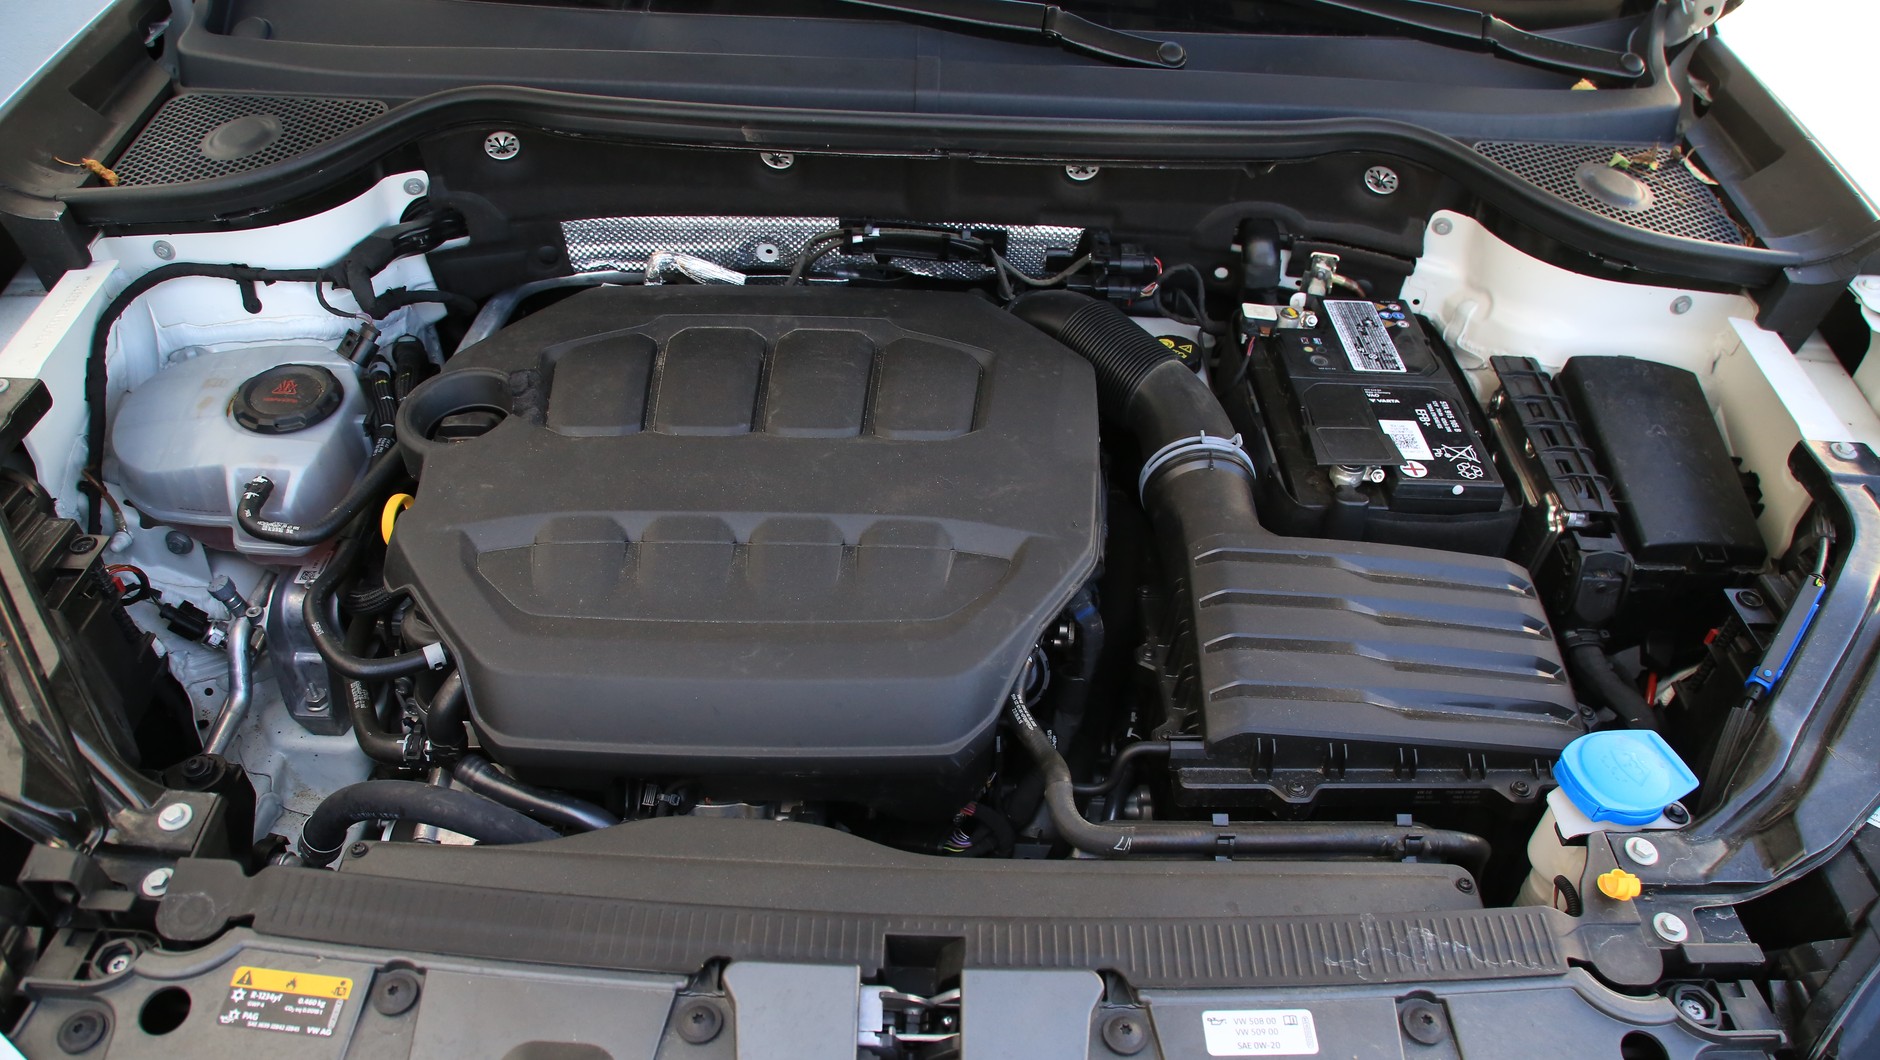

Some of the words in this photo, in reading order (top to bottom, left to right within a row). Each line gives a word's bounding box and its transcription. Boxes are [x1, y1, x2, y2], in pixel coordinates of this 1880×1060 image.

[1415, 409, 1431, 426] EFB+
[1432, 448, 1443, 457] Pb
[250, 991, 283, 1003] R-1234yf
[298, 997, 317, 1006] 0.460
[317, 999, 326, 1008] kg
[242, 1011, 259, 1021] PAG
[1266, 1017, 1276, 1025] 00
[306, 1026, 319, 1035] VW
[319, 1028, 332, 1036] AG
[1251, 1028, 1266, 1036] 509
